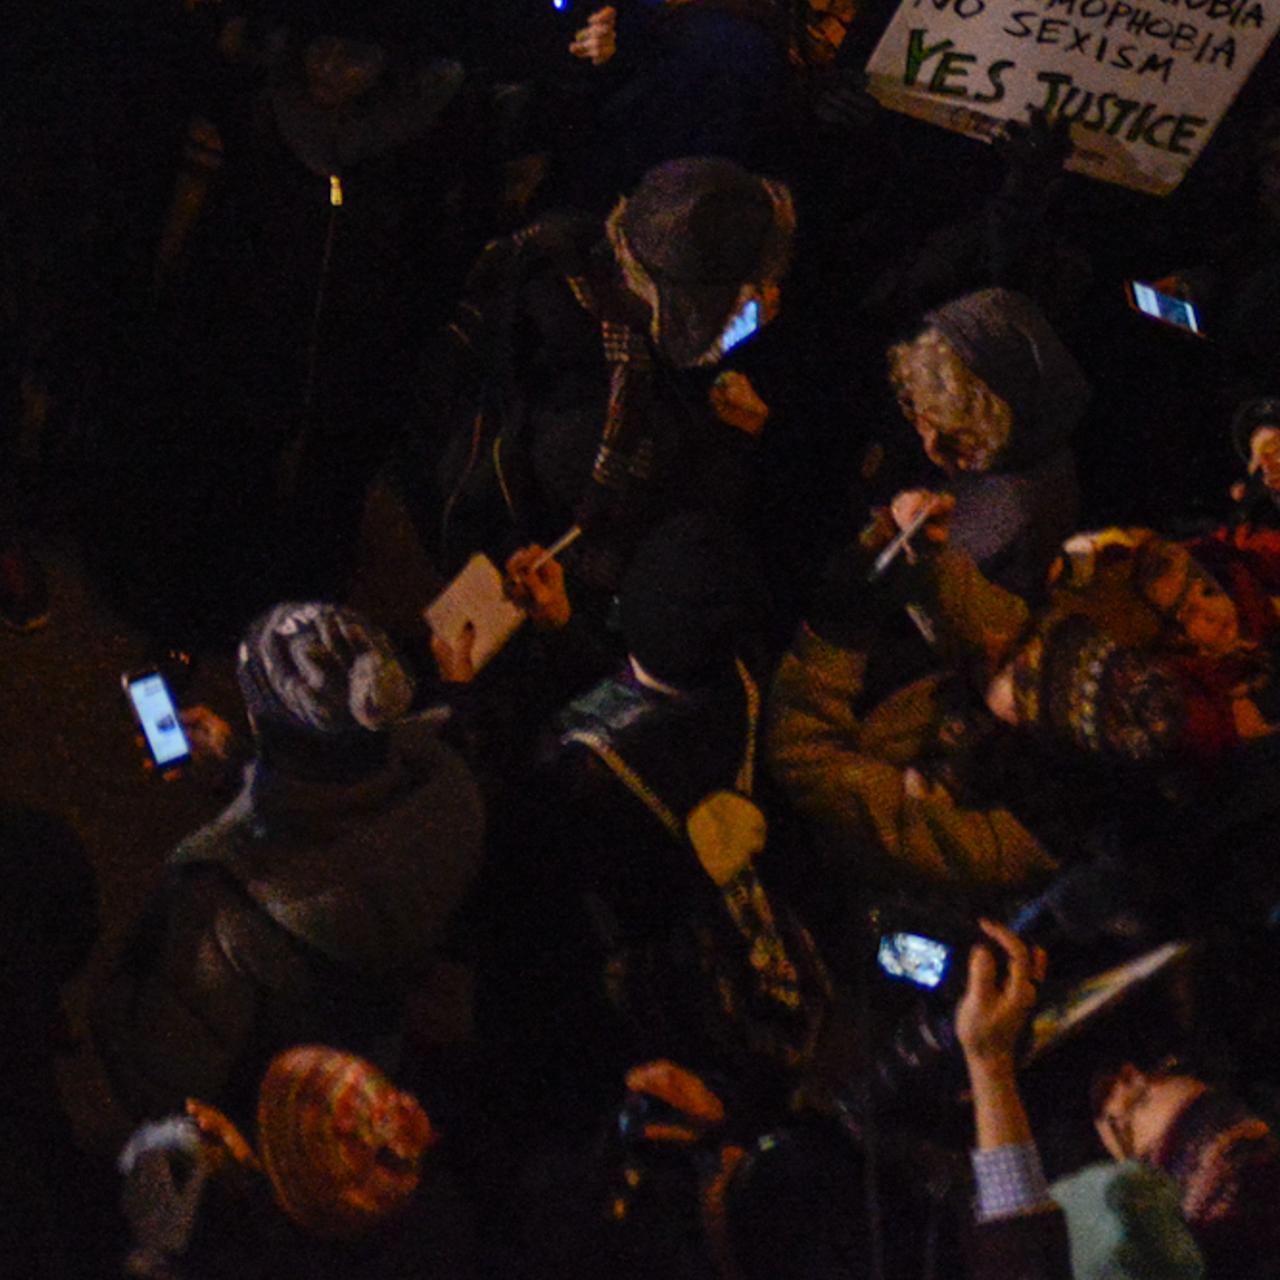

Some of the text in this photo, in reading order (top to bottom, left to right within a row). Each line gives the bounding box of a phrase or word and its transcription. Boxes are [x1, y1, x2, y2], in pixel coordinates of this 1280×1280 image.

[901, 26, 1210, 157] YES JUSTICE
[1003, 8, 1177, 85] SEXISM
